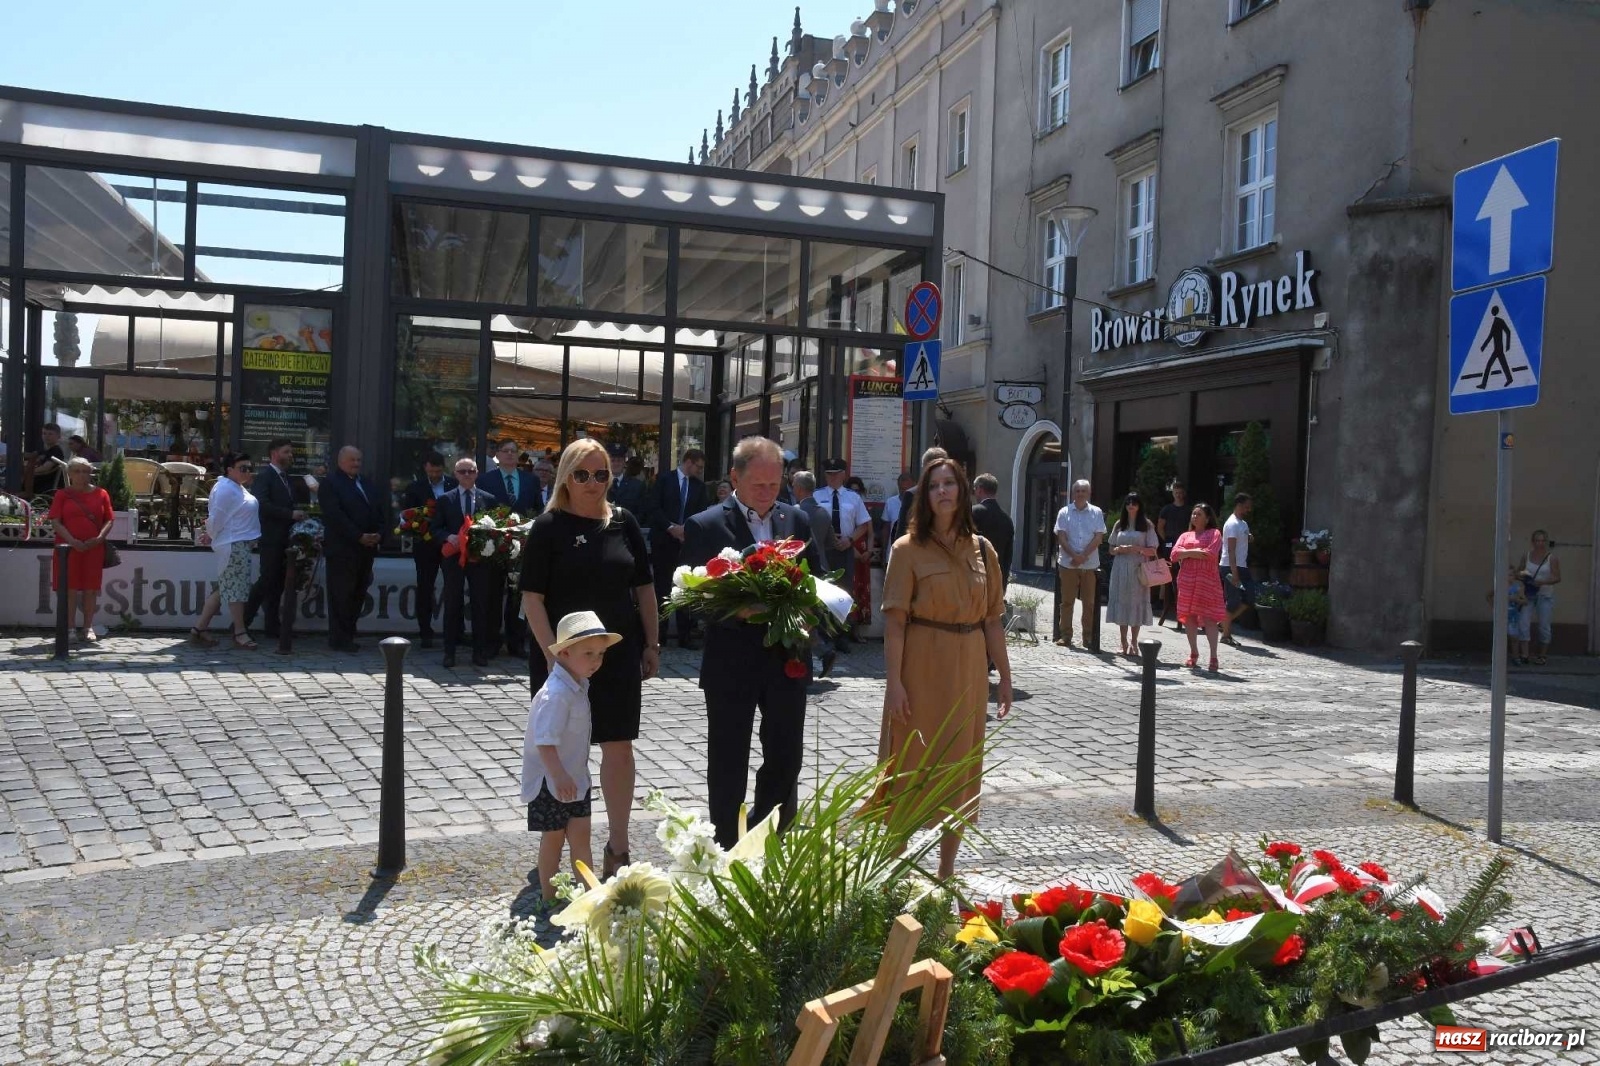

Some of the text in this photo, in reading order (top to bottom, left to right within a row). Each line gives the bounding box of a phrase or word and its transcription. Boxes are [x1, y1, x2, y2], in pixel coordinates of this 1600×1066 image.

[1090, 250, 1315, 353] Browar Rynek
[243, 351, 330, 371] CATERING DIETETYCZNY
[279, 375, 328, 386] BEZ PSZENICY
[860, 380, 898, 392] LUNCH
